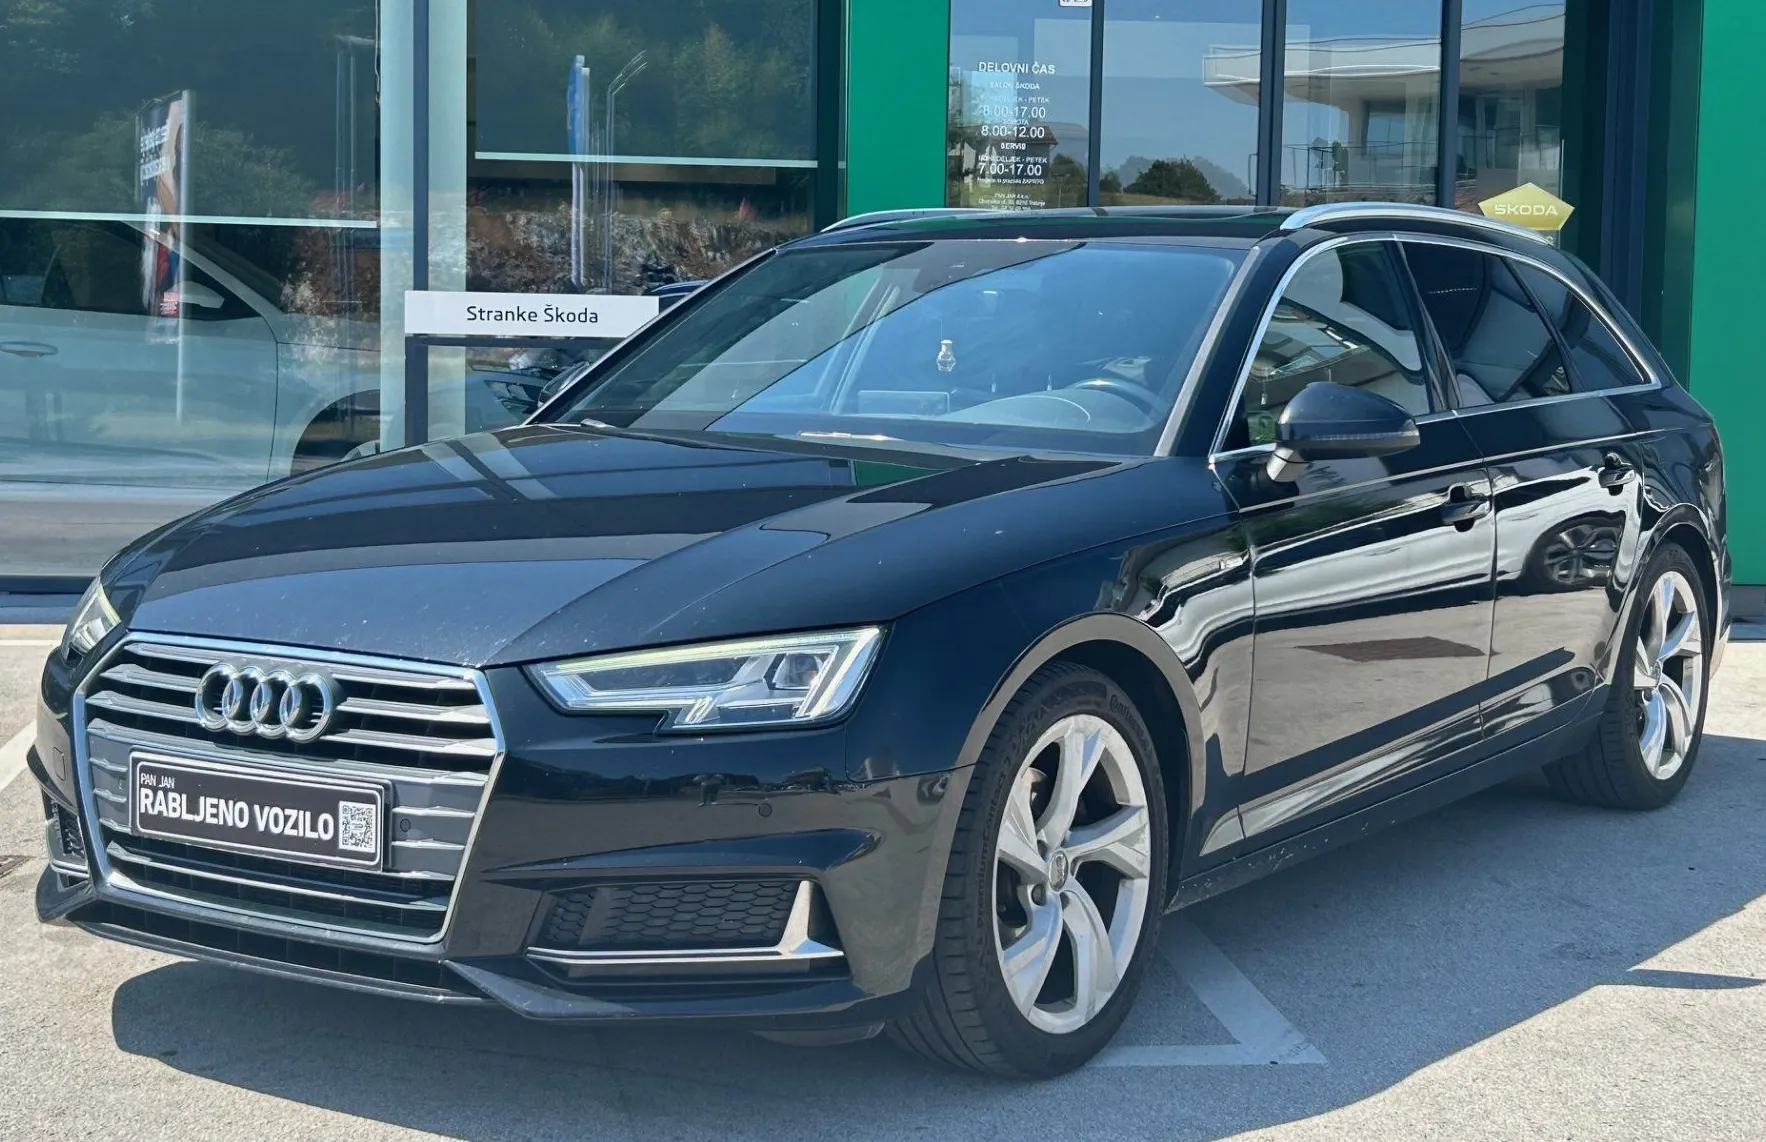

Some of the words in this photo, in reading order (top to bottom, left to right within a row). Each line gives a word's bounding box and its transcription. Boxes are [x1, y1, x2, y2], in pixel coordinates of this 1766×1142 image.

[978, 61, 1029, 74] DELOVNI
[1031, 61, 1056, 75] ČAS
[982, 105, 1046, 119] 8.00-17.00
[981, 125, 1045, 139] 8.00-12.00
[979, 162, 1042, 176] 7.00-17.00
[466, 305, 538, 323] Stranke
[543, 304, 599, 324] Škoda
[140, 773, 156, 786] PAN
[159, 776, 175, 788] JAN
[140, 788, 249, 829] RABLJENO
[254, 804, 334, 841] VOZILO
